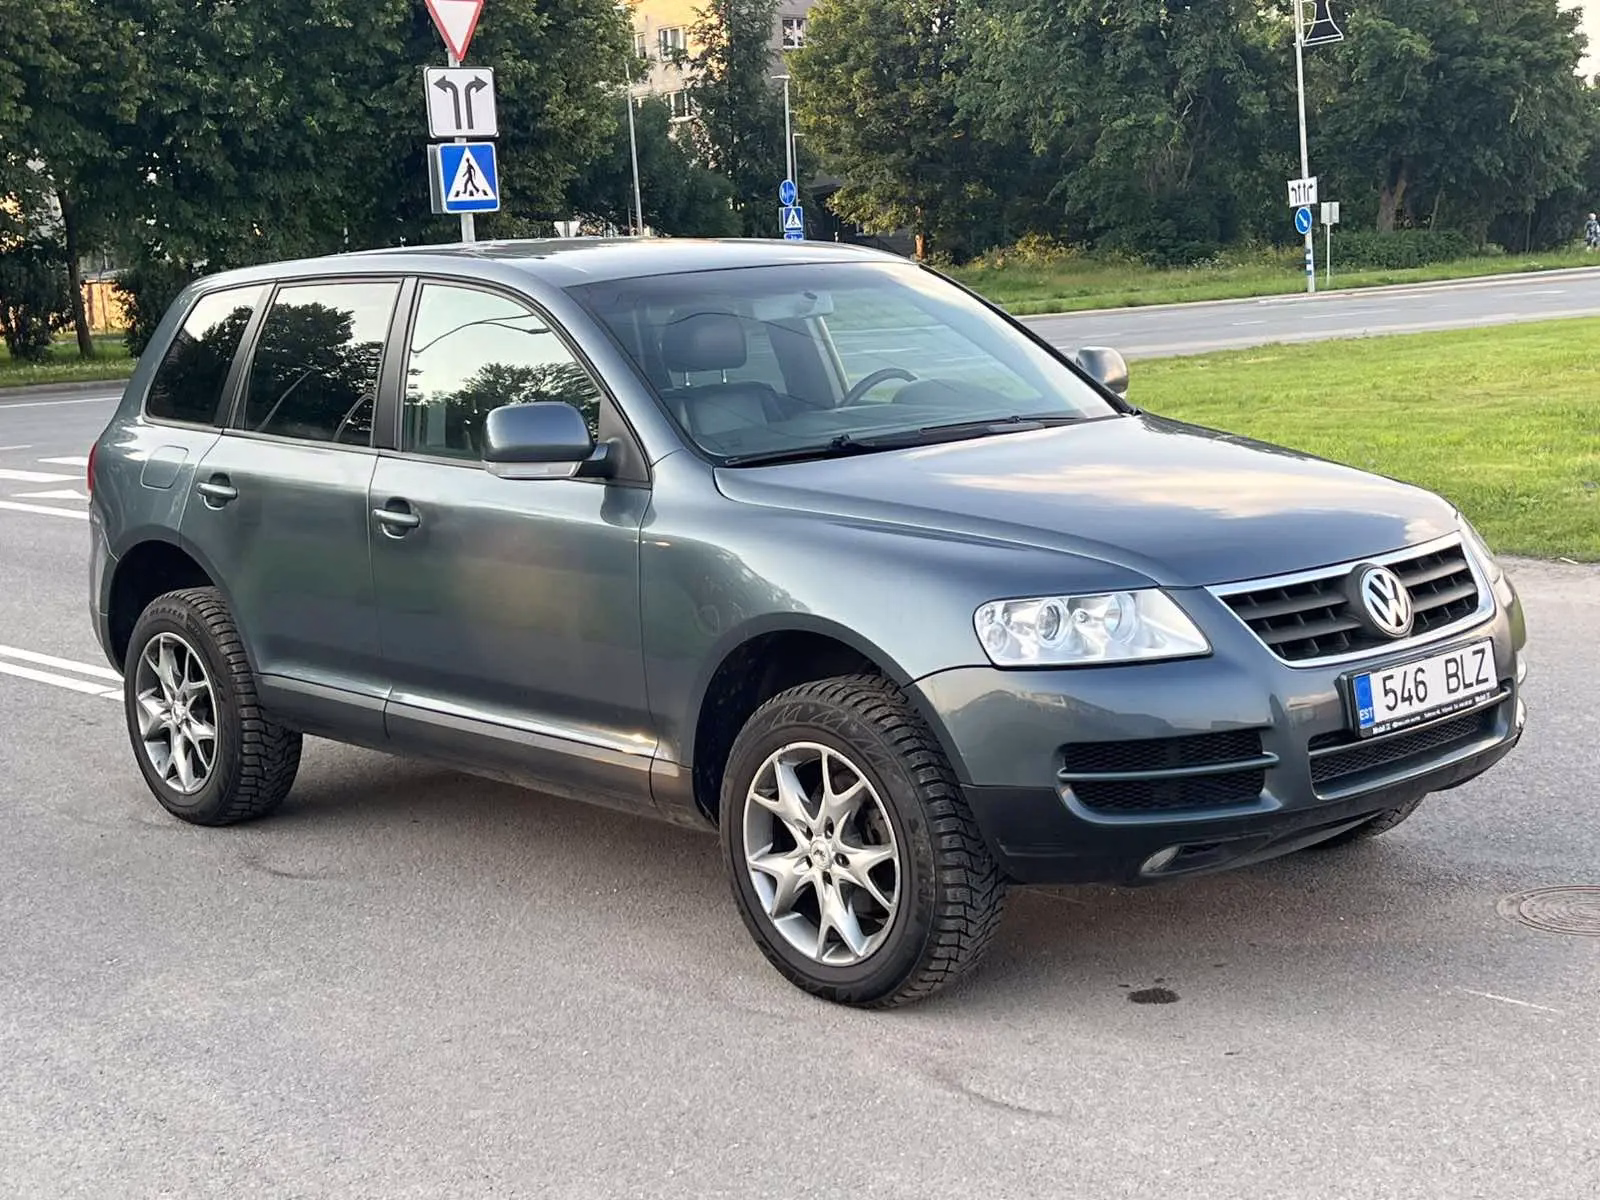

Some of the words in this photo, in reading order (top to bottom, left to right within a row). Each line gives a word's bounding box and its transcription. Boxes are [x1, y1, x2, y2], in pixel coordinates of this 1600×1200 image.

[1363, 568, 1412, 635] VW
[1382, 667, 1428, 711] 546
[1445, 648, 1489, 694] BLZ
[1359, 706, 1374, 720] EST
